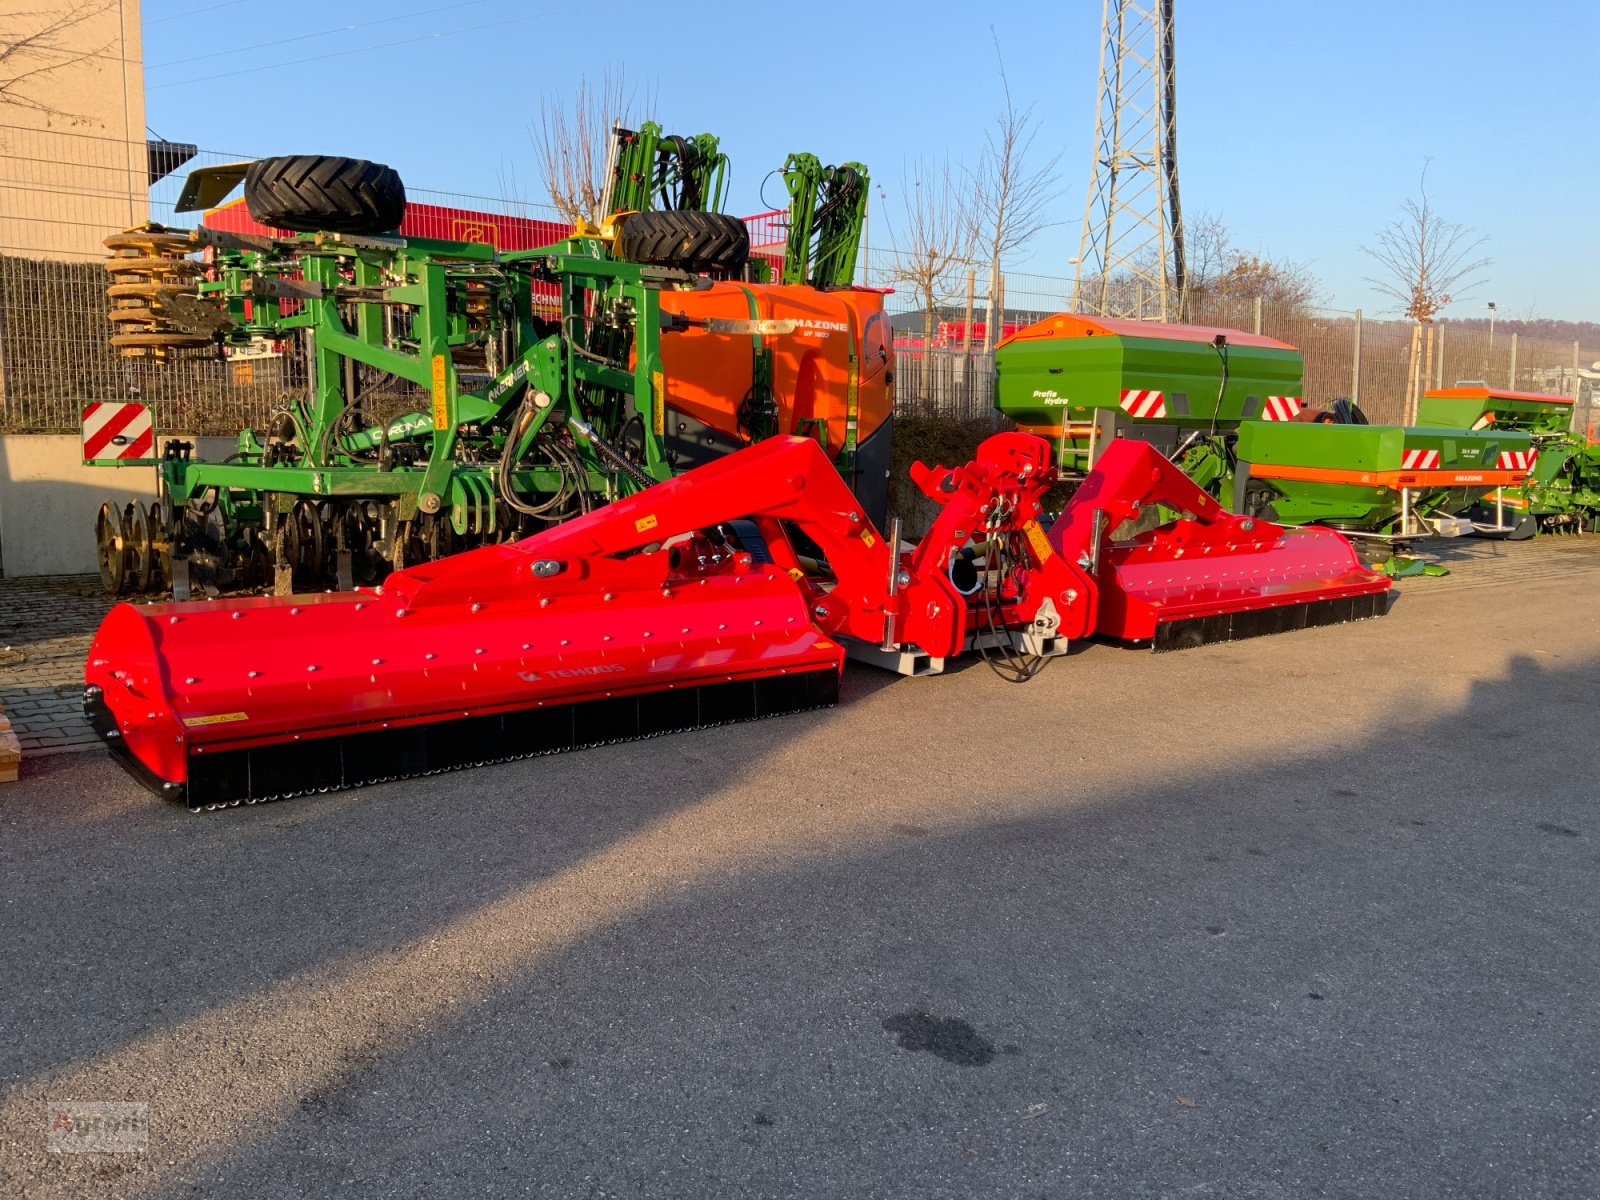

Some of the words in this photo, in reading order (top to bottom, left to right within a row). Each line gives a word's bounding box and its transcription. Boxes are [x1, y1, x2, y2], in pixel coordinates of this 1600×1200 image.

[531, 293, 562, 306] ECHNI
[786, 318, 848, 331] MAZONE
[491, 359, 530, 399] KERNER
[1044, 397, 1069, 406] Hydro
[372, 419, 427, 440] CRONA
